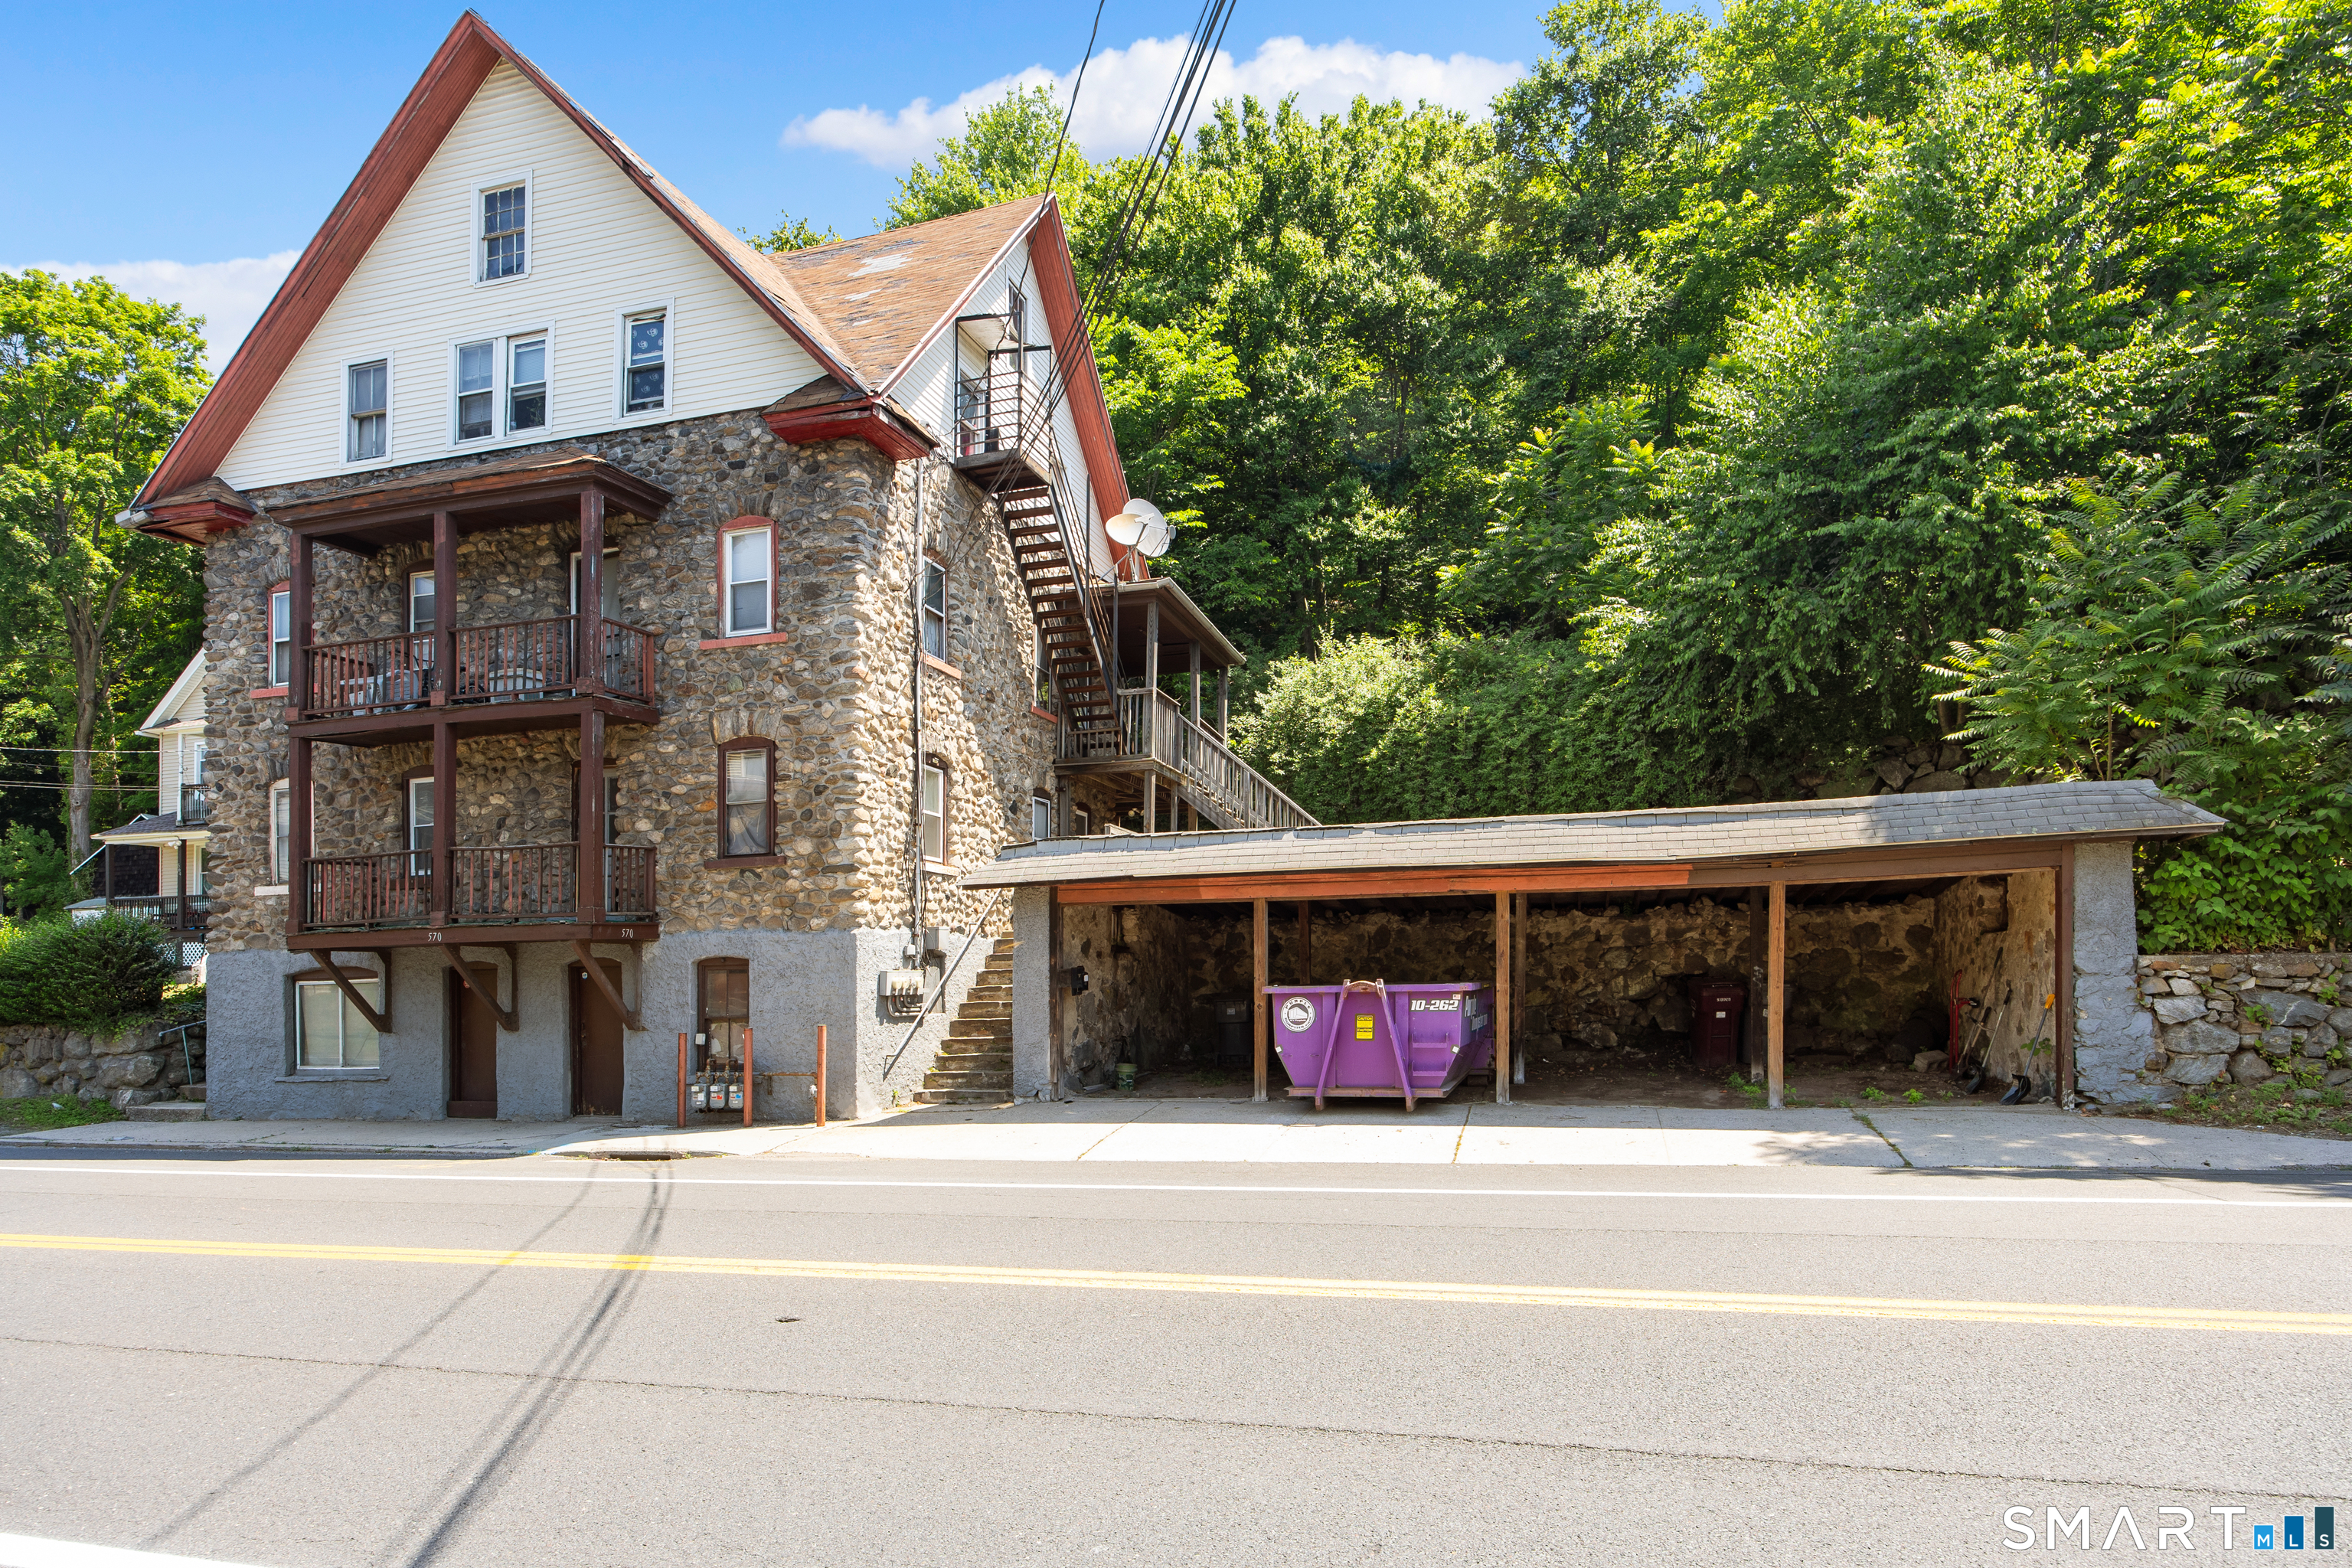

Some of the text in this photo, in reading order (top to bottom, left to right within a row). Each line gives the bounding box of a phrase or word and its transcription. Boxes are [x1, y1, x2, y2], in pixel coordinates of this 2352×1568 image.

[428, 932, 442, 942] 570
[621, 928, 634, 939] 570
[1410, 1000, 1459, 1011] 10-262
